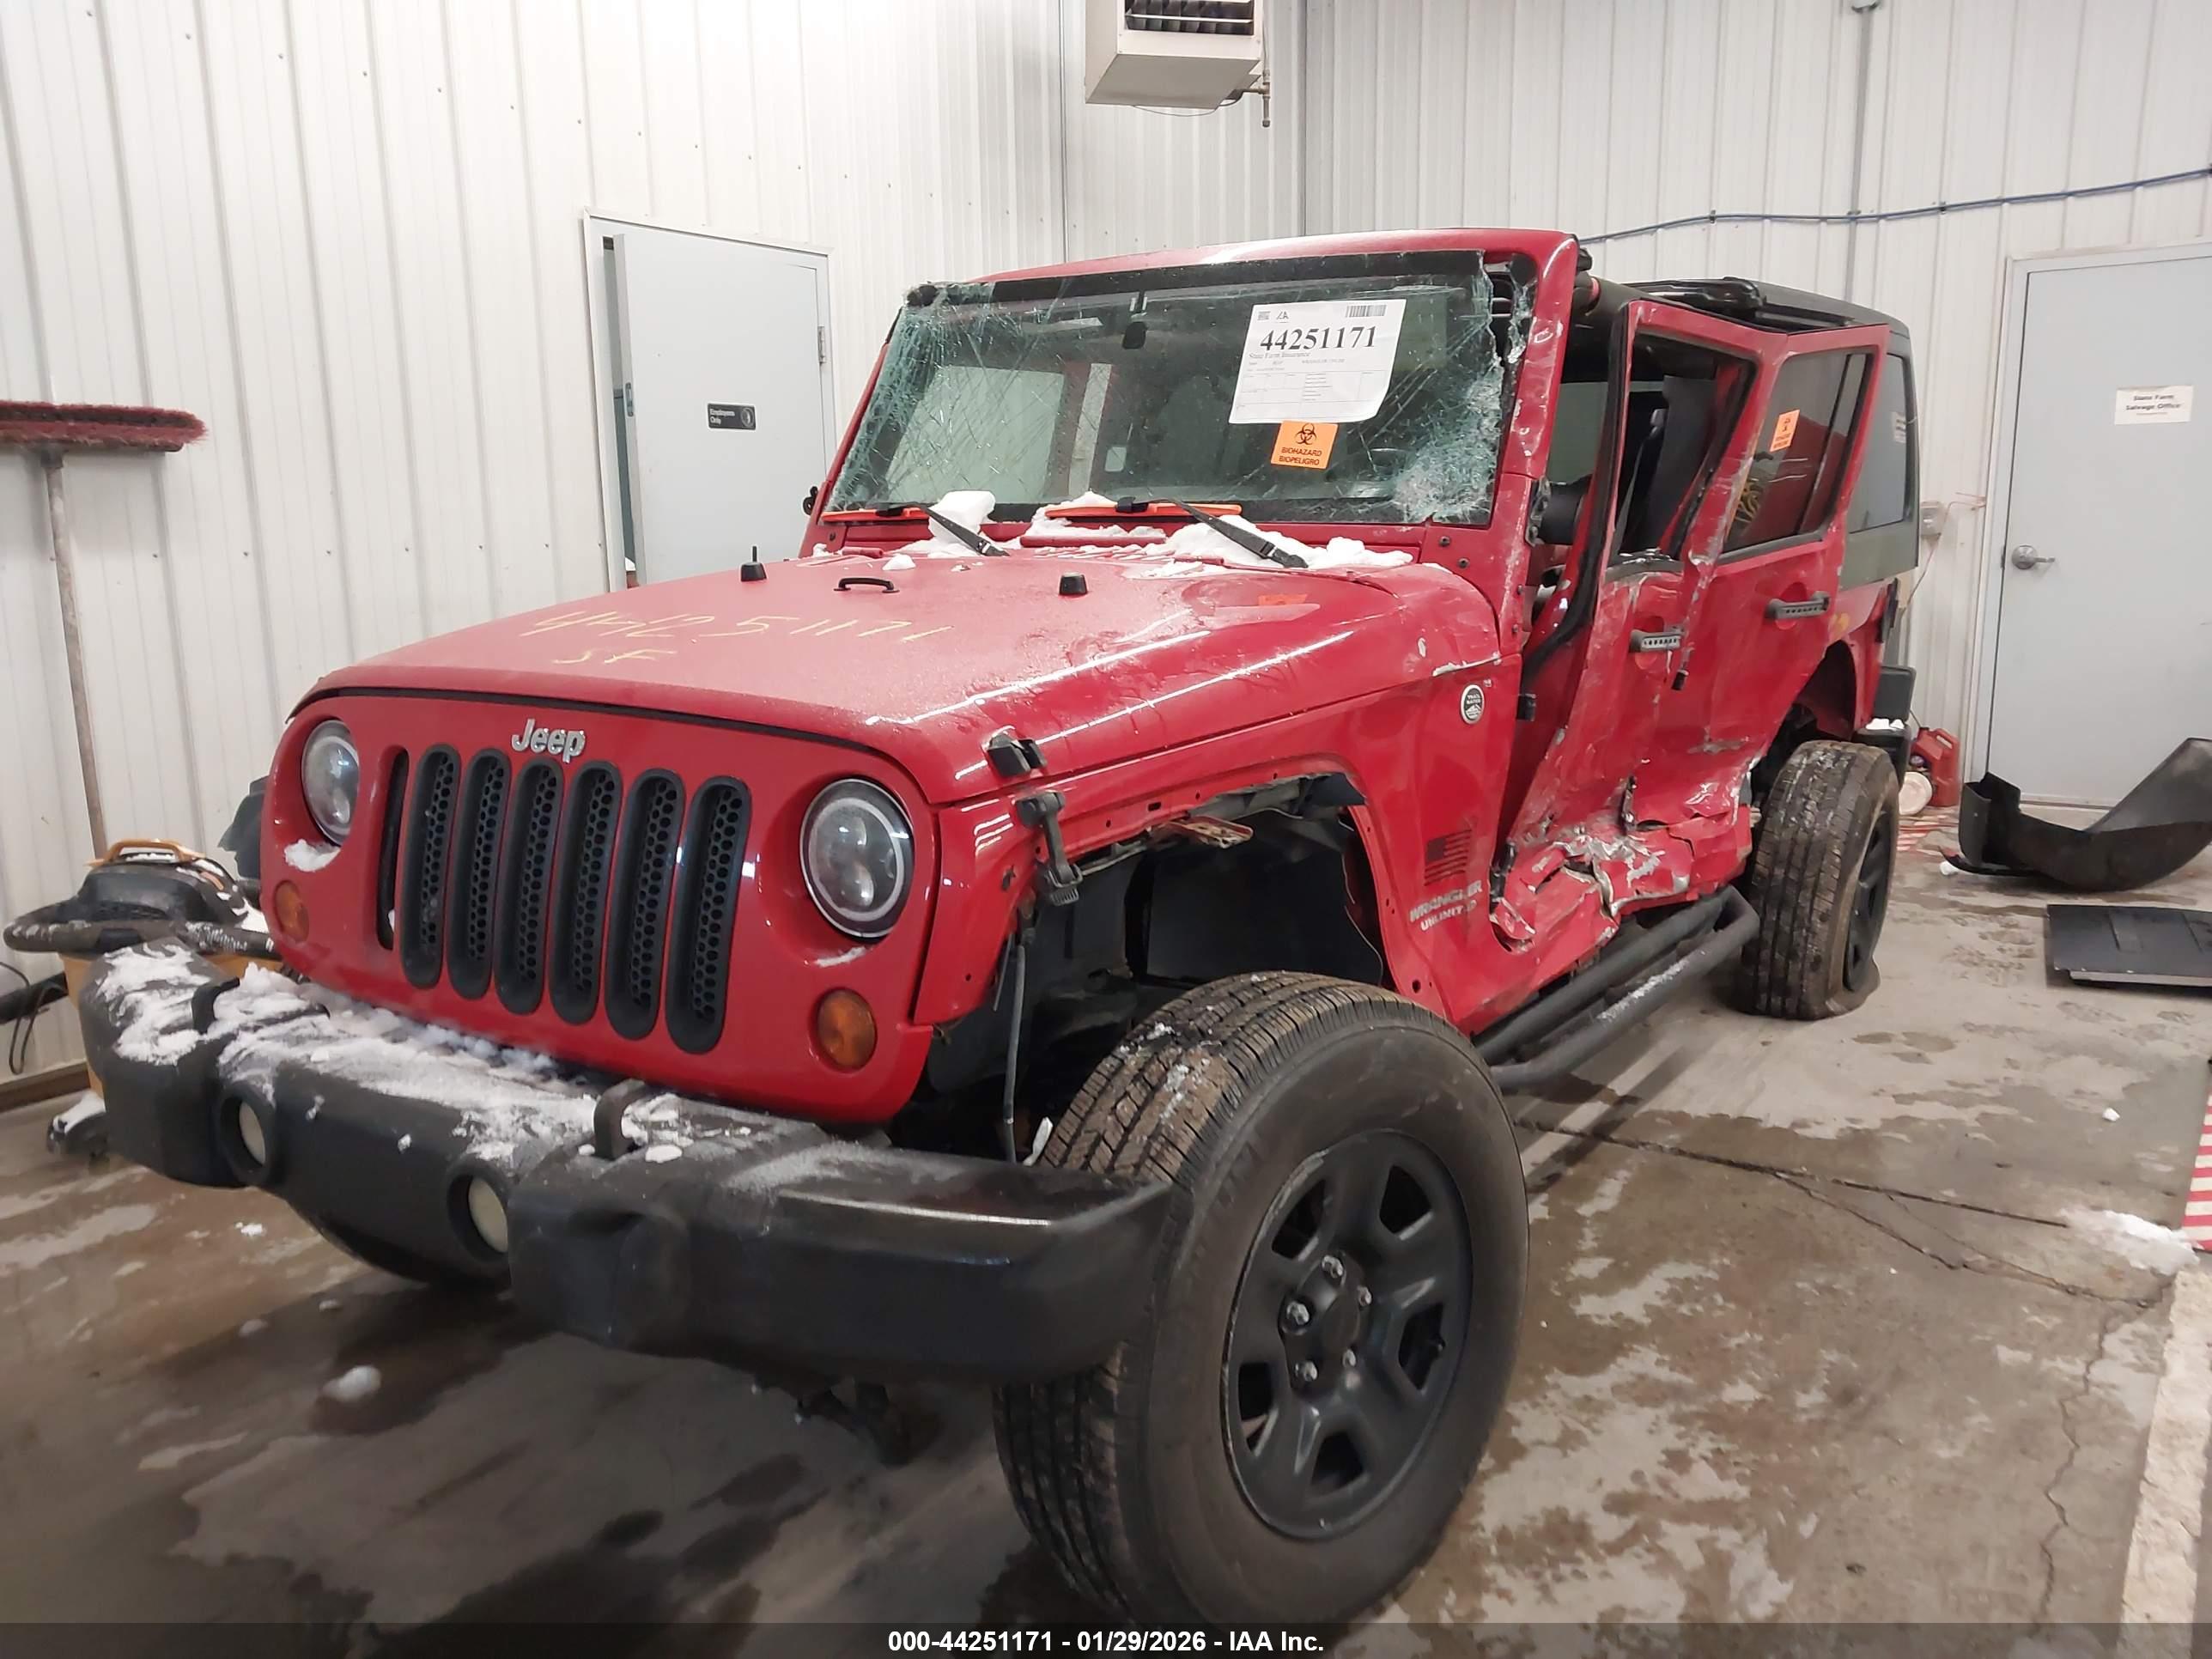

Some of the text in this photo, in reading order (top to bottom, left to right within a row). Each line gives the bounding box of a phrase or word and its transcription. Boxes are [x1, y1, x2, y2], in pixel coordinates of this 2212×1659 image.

[1260, 325, 1376, 351] 44251171
[1279, 455, 1320, 465] BIOPELIGRO
[1280, 447, 1322, 457] BIOHAZARD
[511, 718, 586, 763] Jeep
[1420, 899, 1477, 932] UNLIMITD
